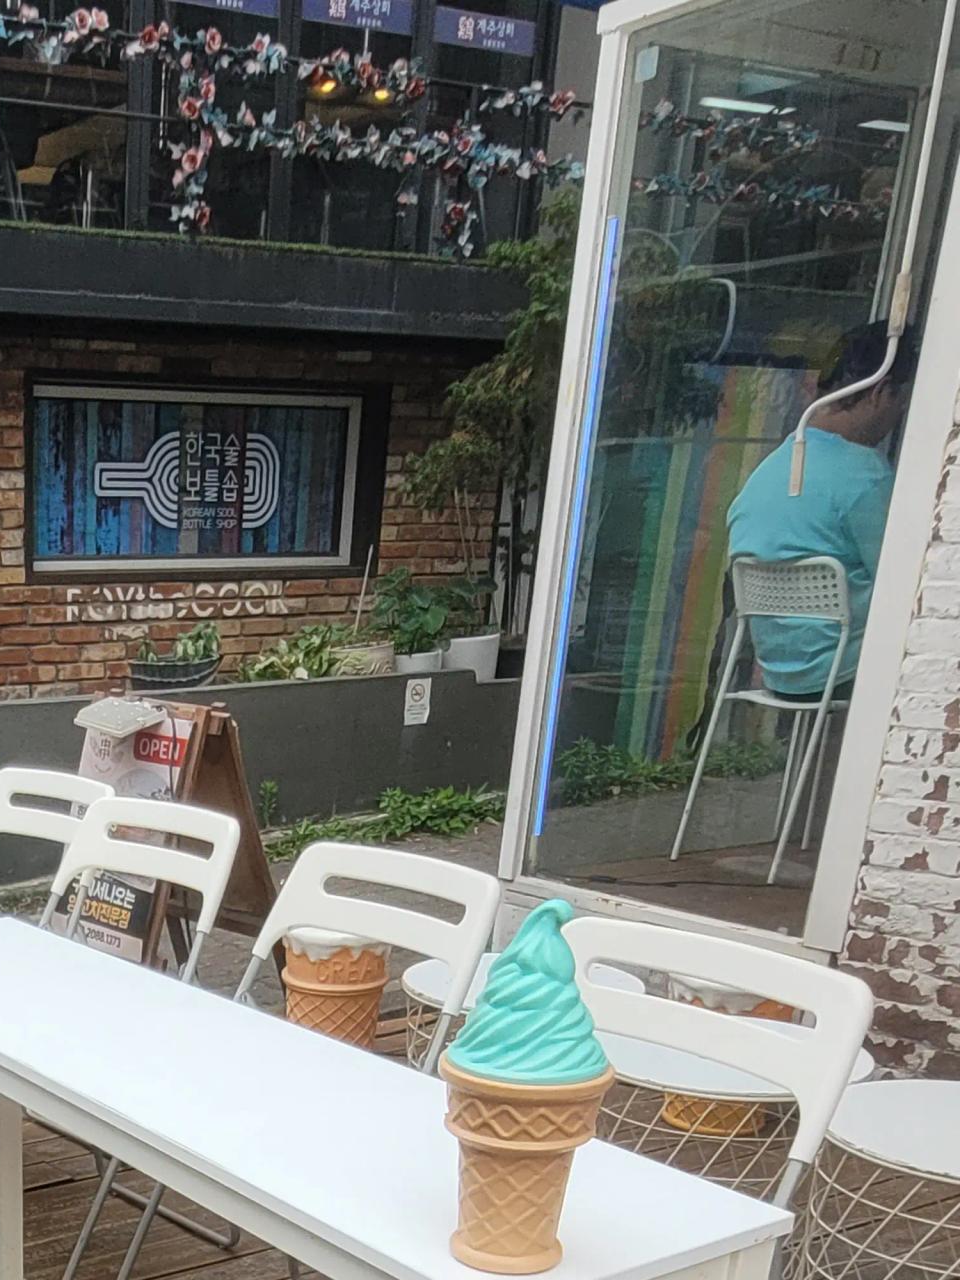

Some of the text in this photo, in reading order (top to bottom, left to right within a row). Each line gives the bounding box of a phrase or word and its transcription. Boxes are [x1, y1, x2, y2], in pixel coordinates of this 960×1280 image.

[185, 431, 241, 467] 한국술
[183, 469, 239, 502] 보틀숍
[182, 507, 238, 518] KOREAN SOOL
[182, 519, 238, 529] BOTTLE SHOP
[140, 738, 180, 761] OPEN
